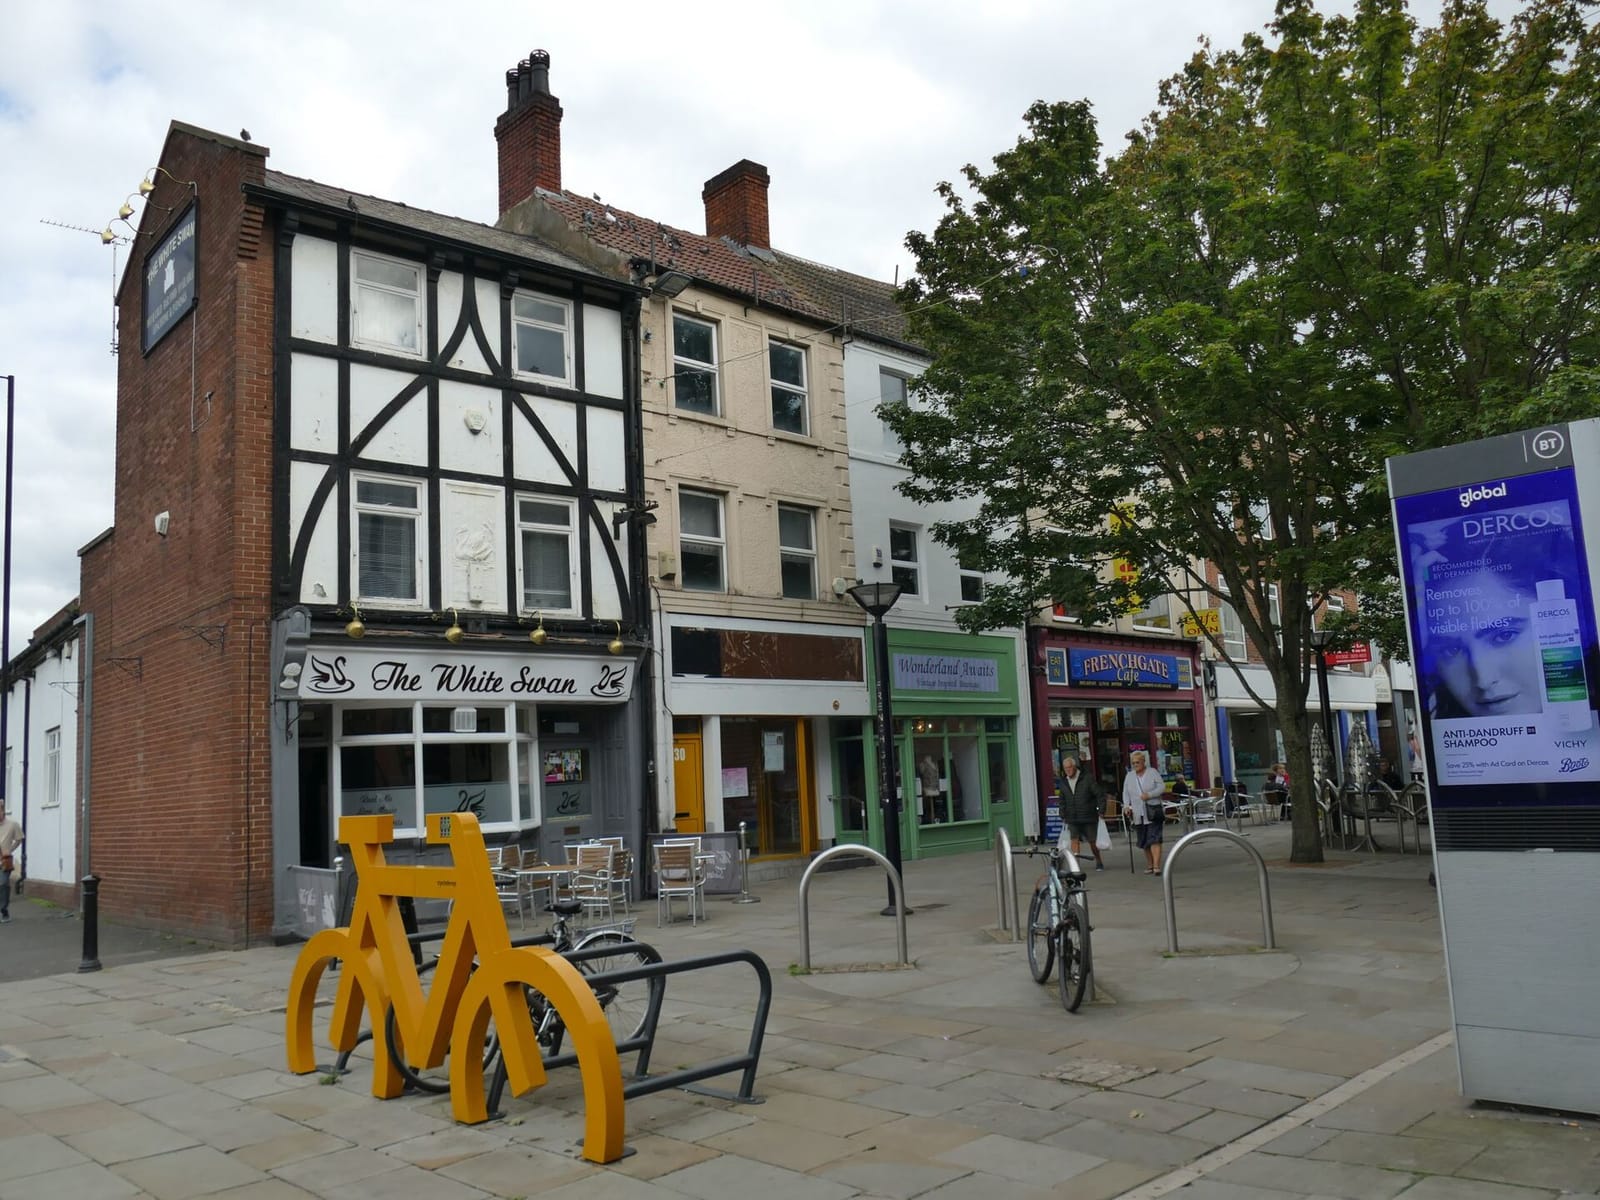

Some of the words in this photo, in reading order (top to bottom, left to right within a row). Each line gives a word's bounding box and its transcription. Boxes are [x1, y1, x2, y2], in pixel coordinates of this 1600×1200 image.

[147, 262, 159, 287] THE
[159, 236, 177, 266] WHITE
[177, 221, 195, 246] SWAN
[1539, 438, 1557, 452] BT
[1459, 482, 1507, 508] global
[1463, 507, 1564, 539] DERCOS
[1432, 558, 1493, 572] RECOMMENDED
[1426, 584, 1482, 601] Removes
[1428, 606, 1444, 619] up
[1447, 604, 1461, 616] to
[1537, 608, 1571, 619] DERCOS
[1430, 619, 1468, 635] visible
[899, 658, 960, 675] Wonderland
[960, 662, 995, 677] Awaits
[1084, 653, 1169, 679] FRENCHGATE
[371, 661, 422, 692] The
[431, 663, 504, 694] White
[511, 665, 578, 695] Swan
[1116, 667, 1140, 686] Cafe
[1443, 727, 1524, 739] ANTI-DANDRUFF
[1444, 738, 1498, 749] SHAMPOO
[1554, 740, 1588, 749] VICHY
[674, 748, 686, 761] 30
[1476, 760, 1489, 768] with
[1558, 757, 1590, 773] Boots
